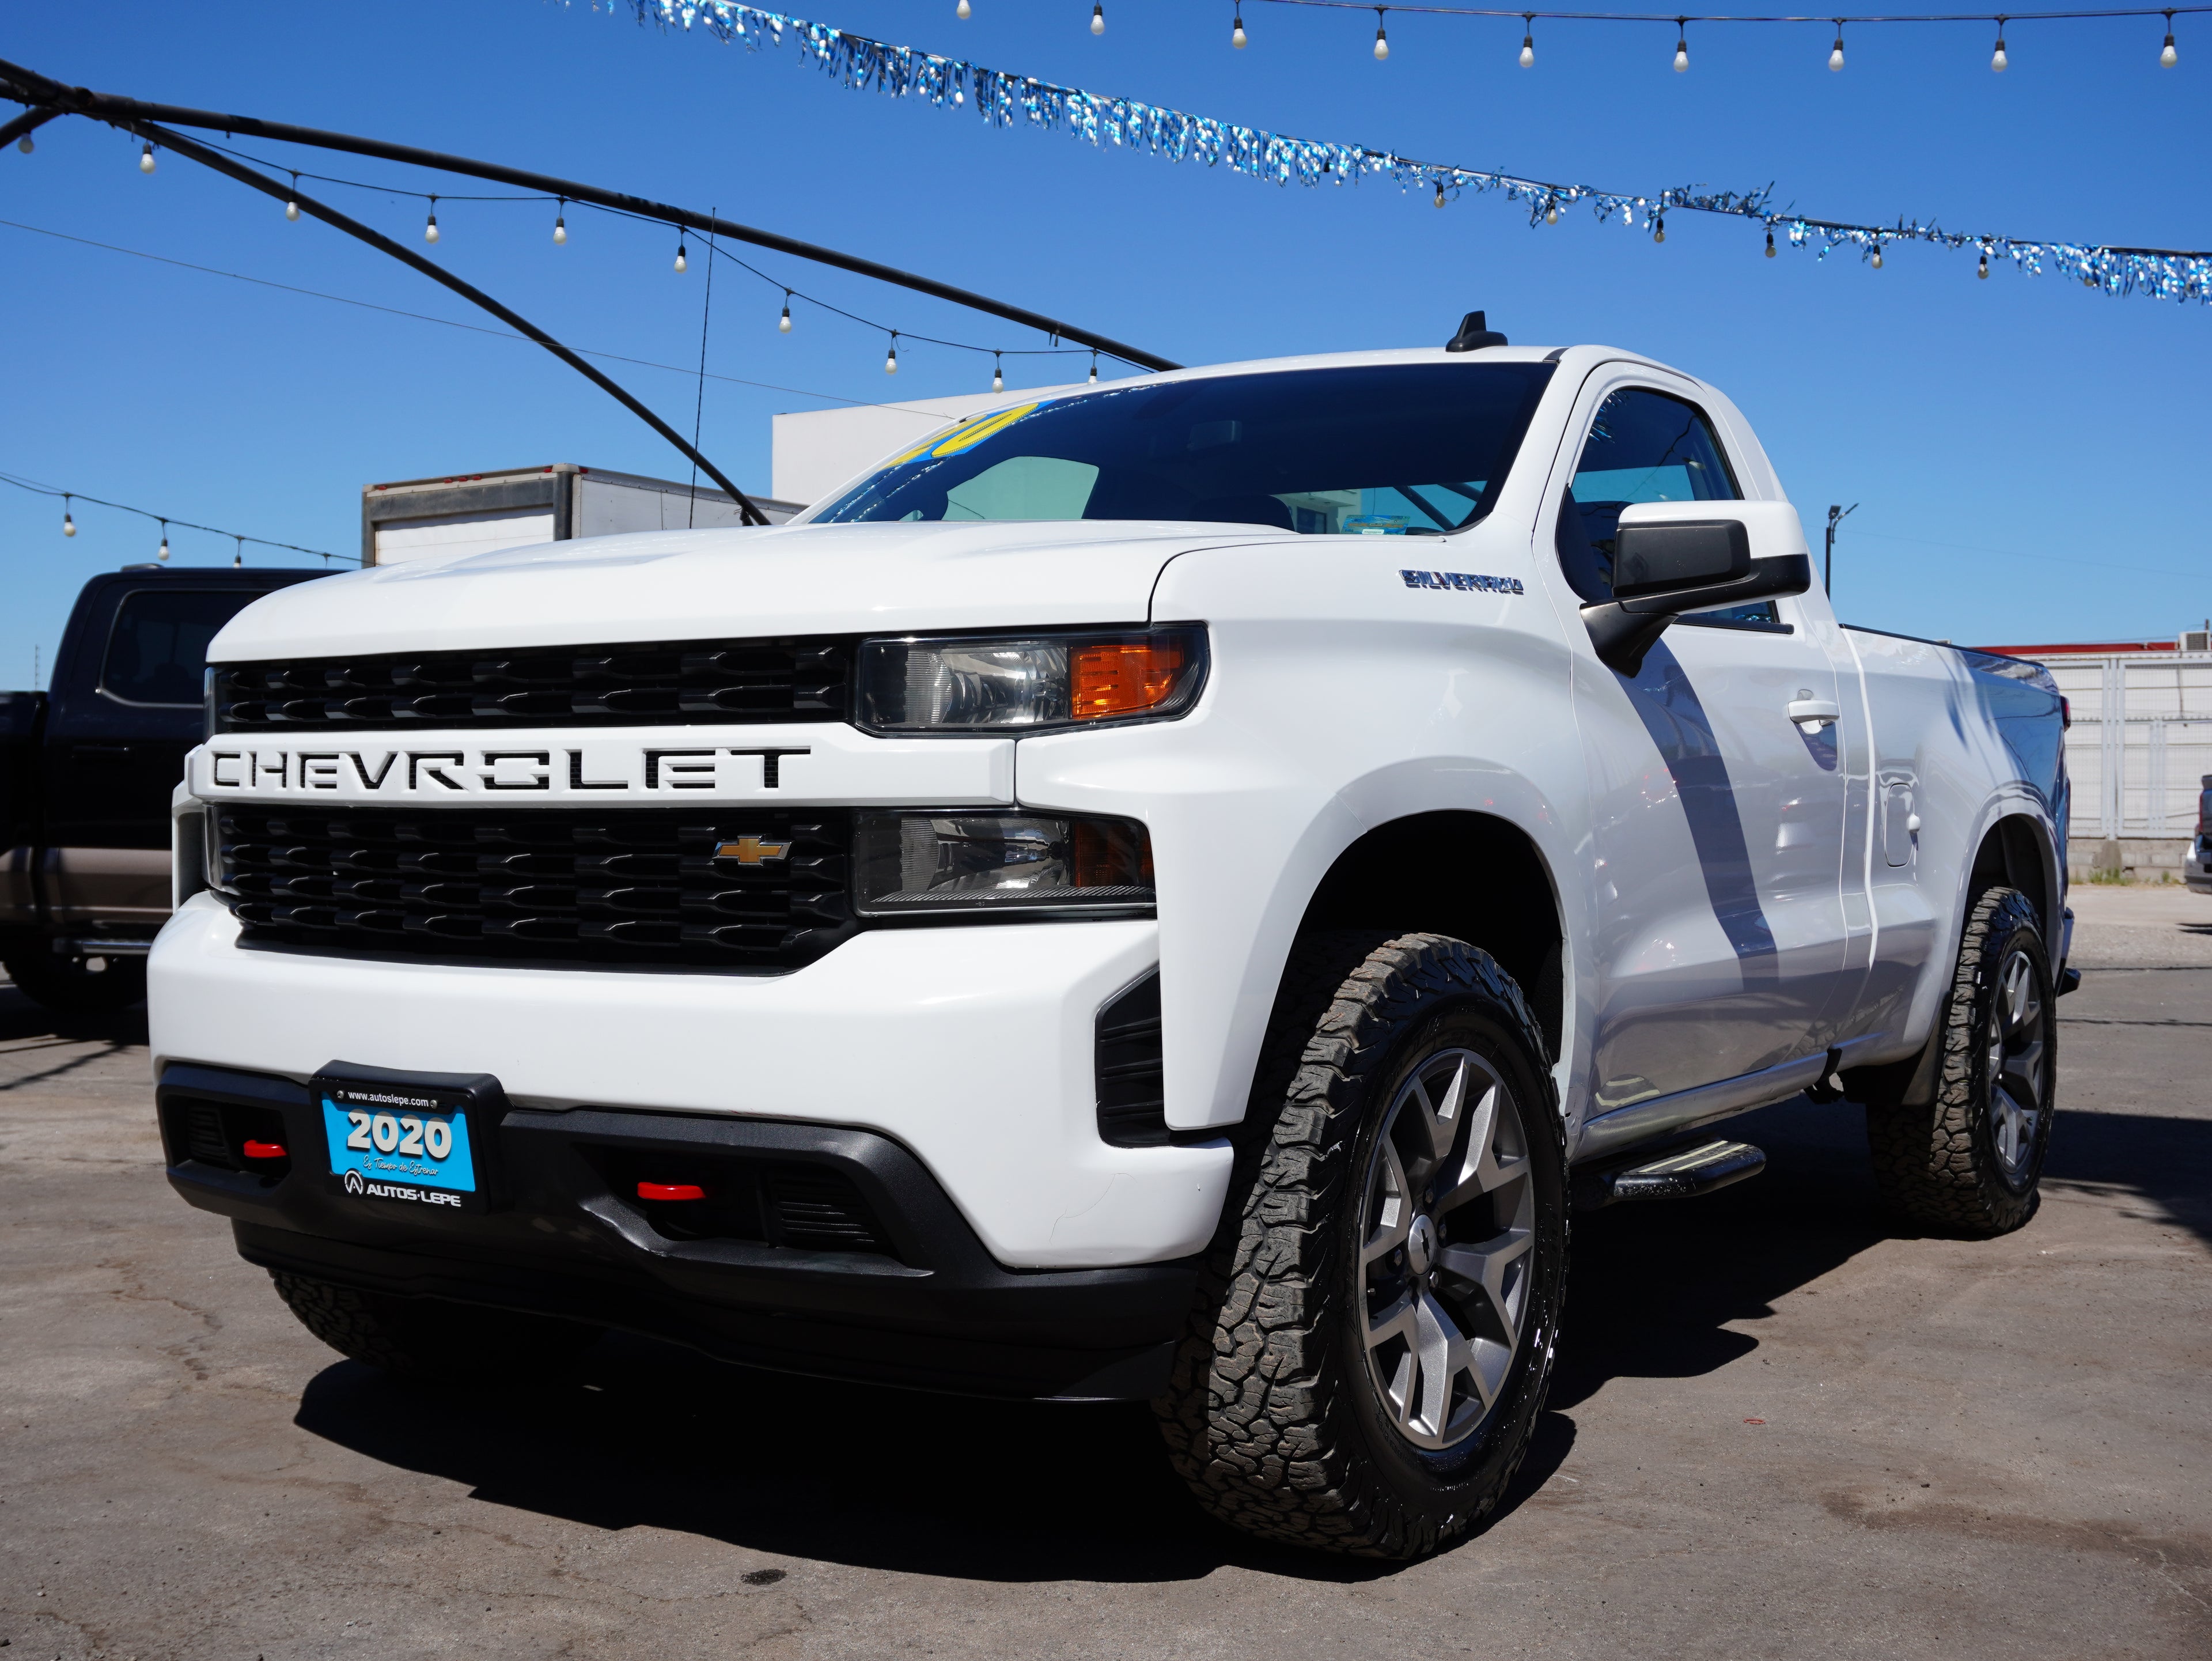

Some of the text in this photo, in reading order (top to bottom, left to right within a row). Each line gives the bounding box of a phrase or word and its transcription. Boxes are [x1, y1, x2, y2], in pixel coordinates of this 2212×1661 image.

[1398, 569, 1524, 593] SILVERADO
[211, 746, 812, 790] CHEVROLET
[348, 1091, 429, 1107] www.autoslepe.com
[347, 1108, 452, 1159] 2020
[363, 1154, 438, 1175] Es Tiempo de Estrenar
